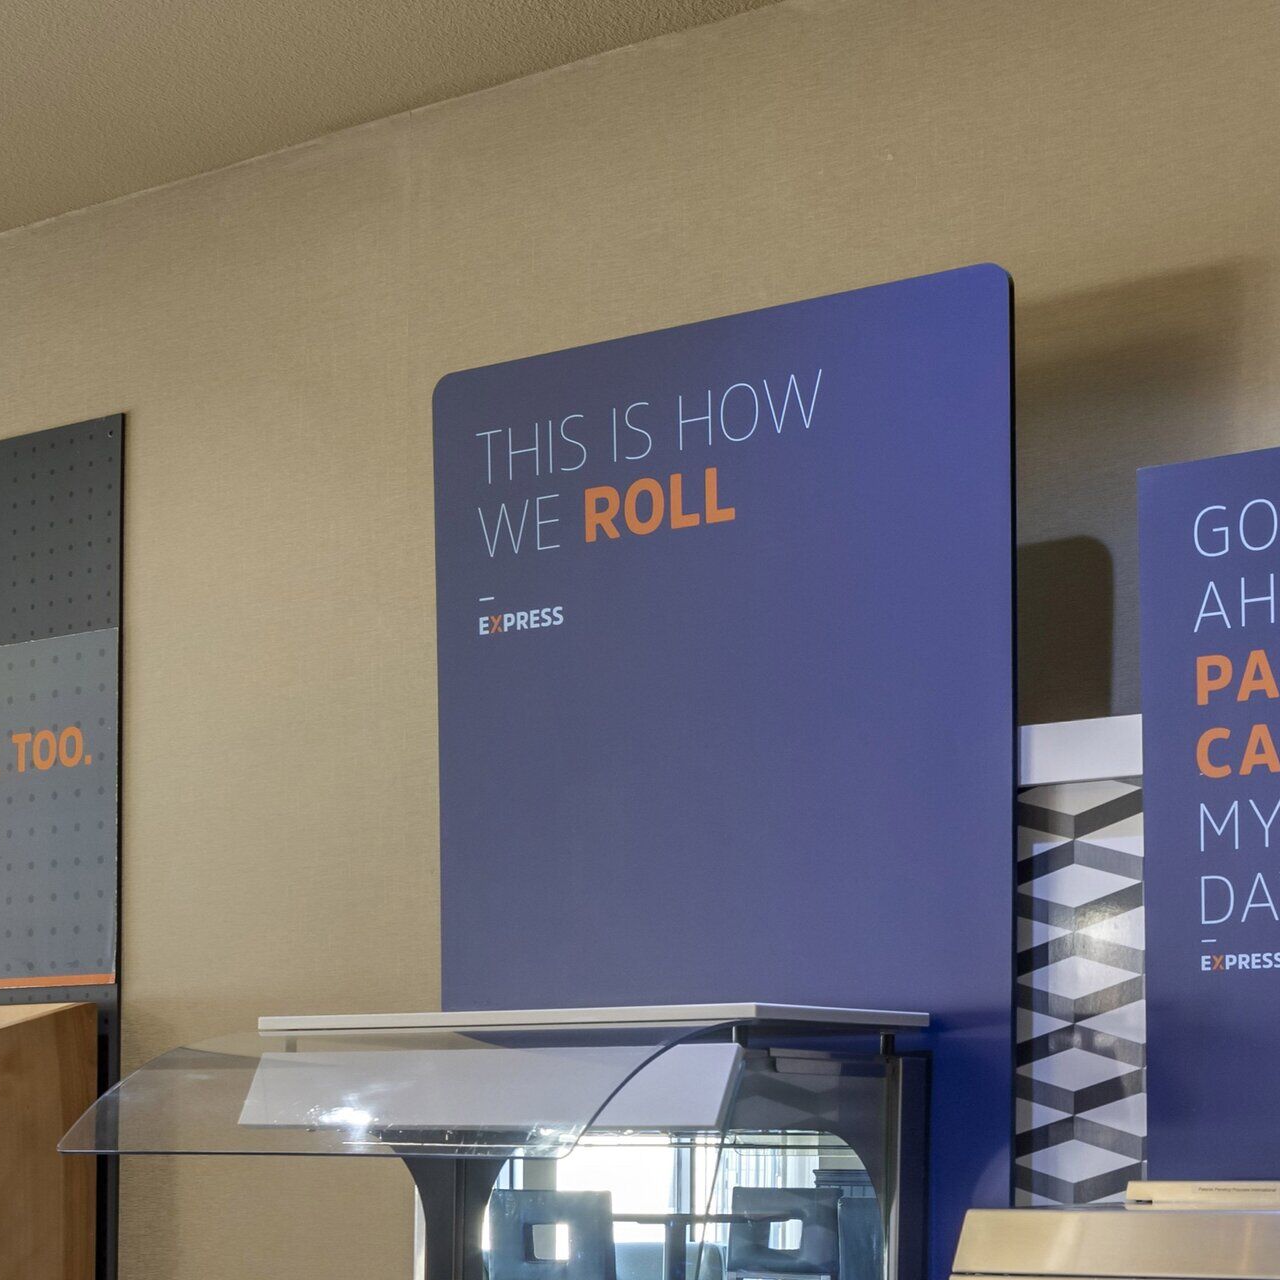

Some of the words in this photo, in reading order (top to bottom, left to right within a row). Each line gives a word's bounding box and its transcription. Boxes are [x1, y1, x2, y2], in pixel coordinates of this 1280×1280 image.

[476, 415, 586, 484] THIS
[613, 402, 652, 462] IS
[679, 369, 822, 450] HOW
[478, 494, 560, 557] WE
[584, 468, 735, 542] ROLL
[1194, 499, 1278, 557] GO
[479, 606, 564, 635] EXPRESS
[11, 725, 92, 773] TOO.
